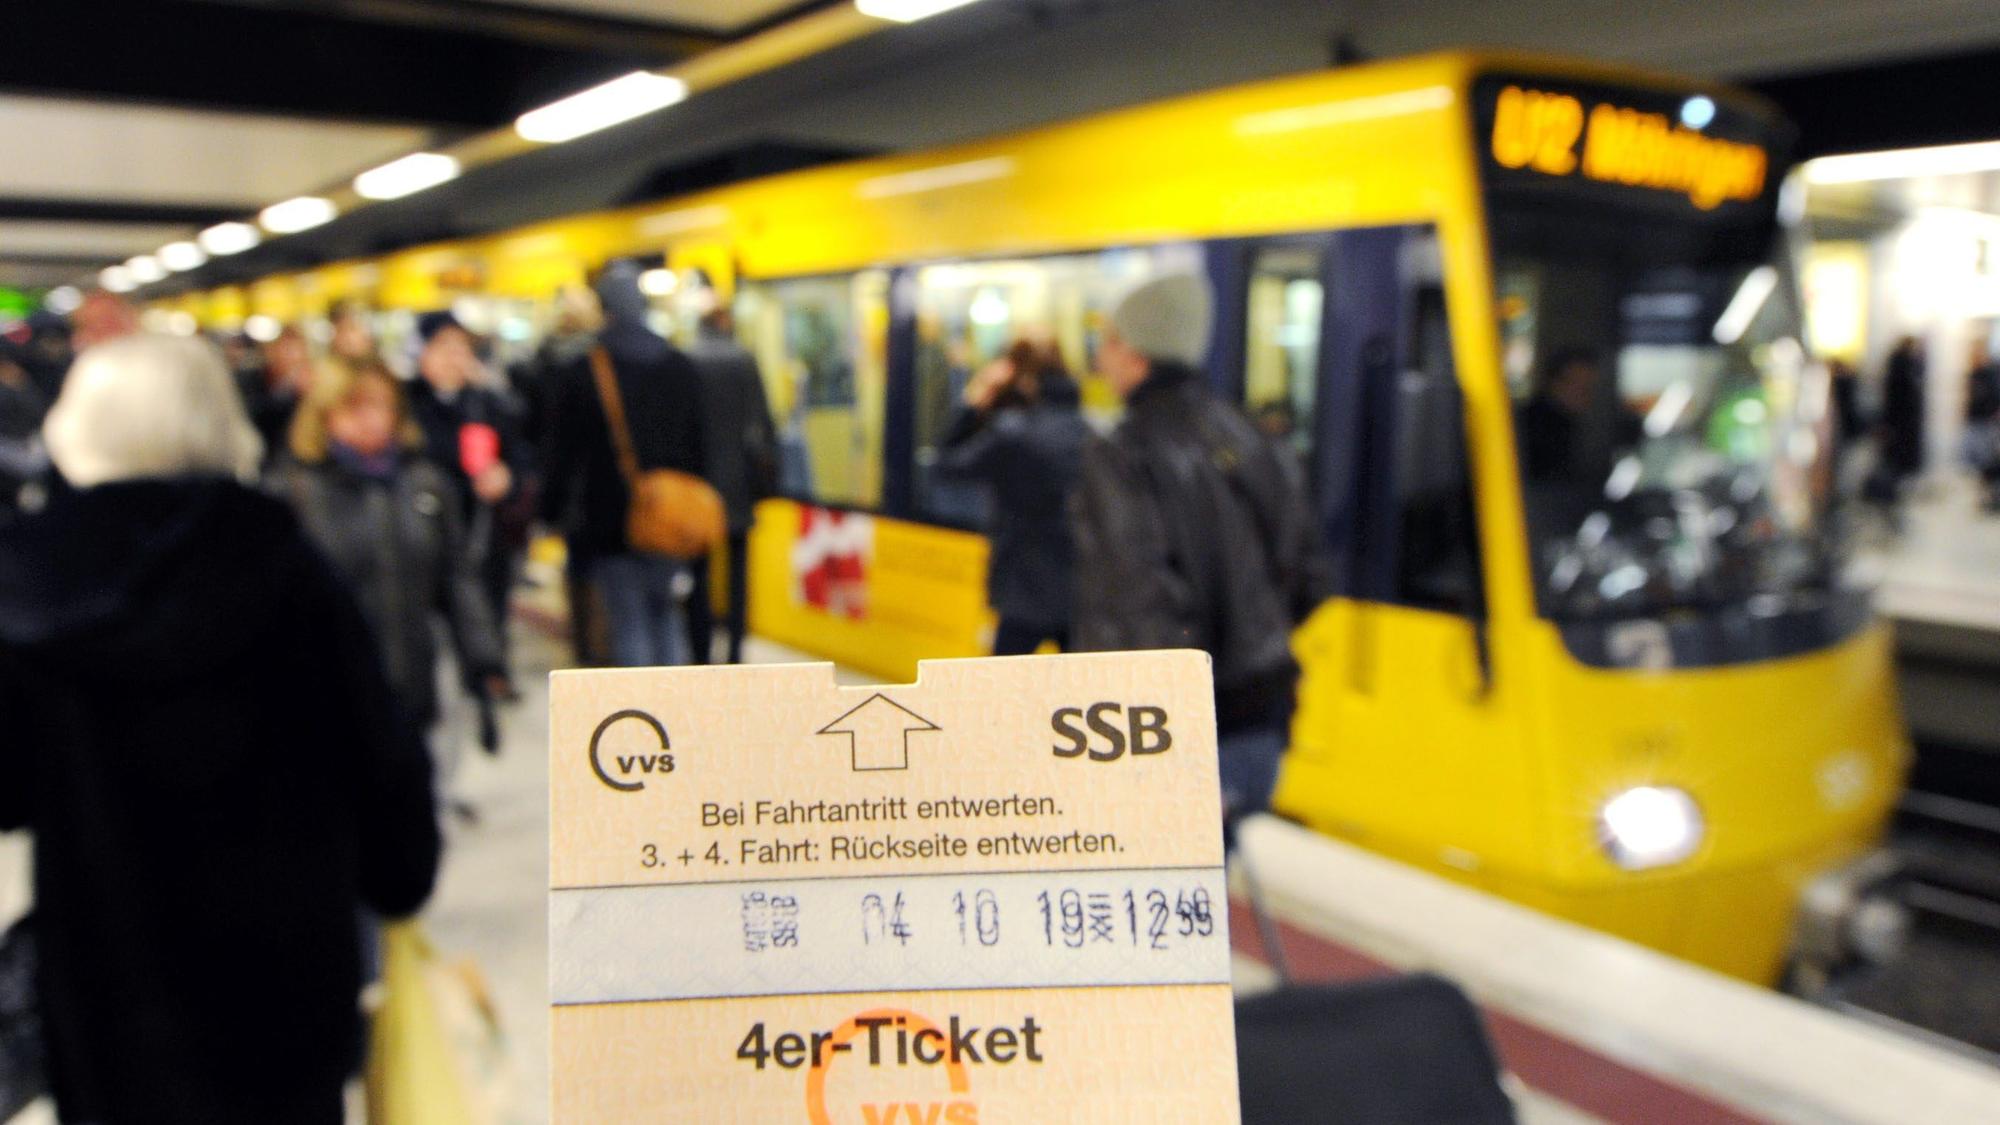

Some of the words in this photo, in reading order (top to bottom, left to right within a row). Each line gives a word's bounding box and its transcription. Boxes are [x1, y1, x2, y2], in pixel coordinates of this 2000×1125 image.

[1051, 702, 1172, 762] SSB
[702, 802, 744, 827] Bei
[756, 797, 907, 825] Fahrtantritt
[917, 795, 1062, 819] entwerten.
[643, 844, 665, 867] 3.
[705, 842, 728, 865] 4.
[741, 839, 818, 863] Fahrt:
[831, 834, 967, 860] Rückseite
[977, 831, 1123, 856] entwerten.
[737, 1016, 1043, 1070] 4er-Ticket
